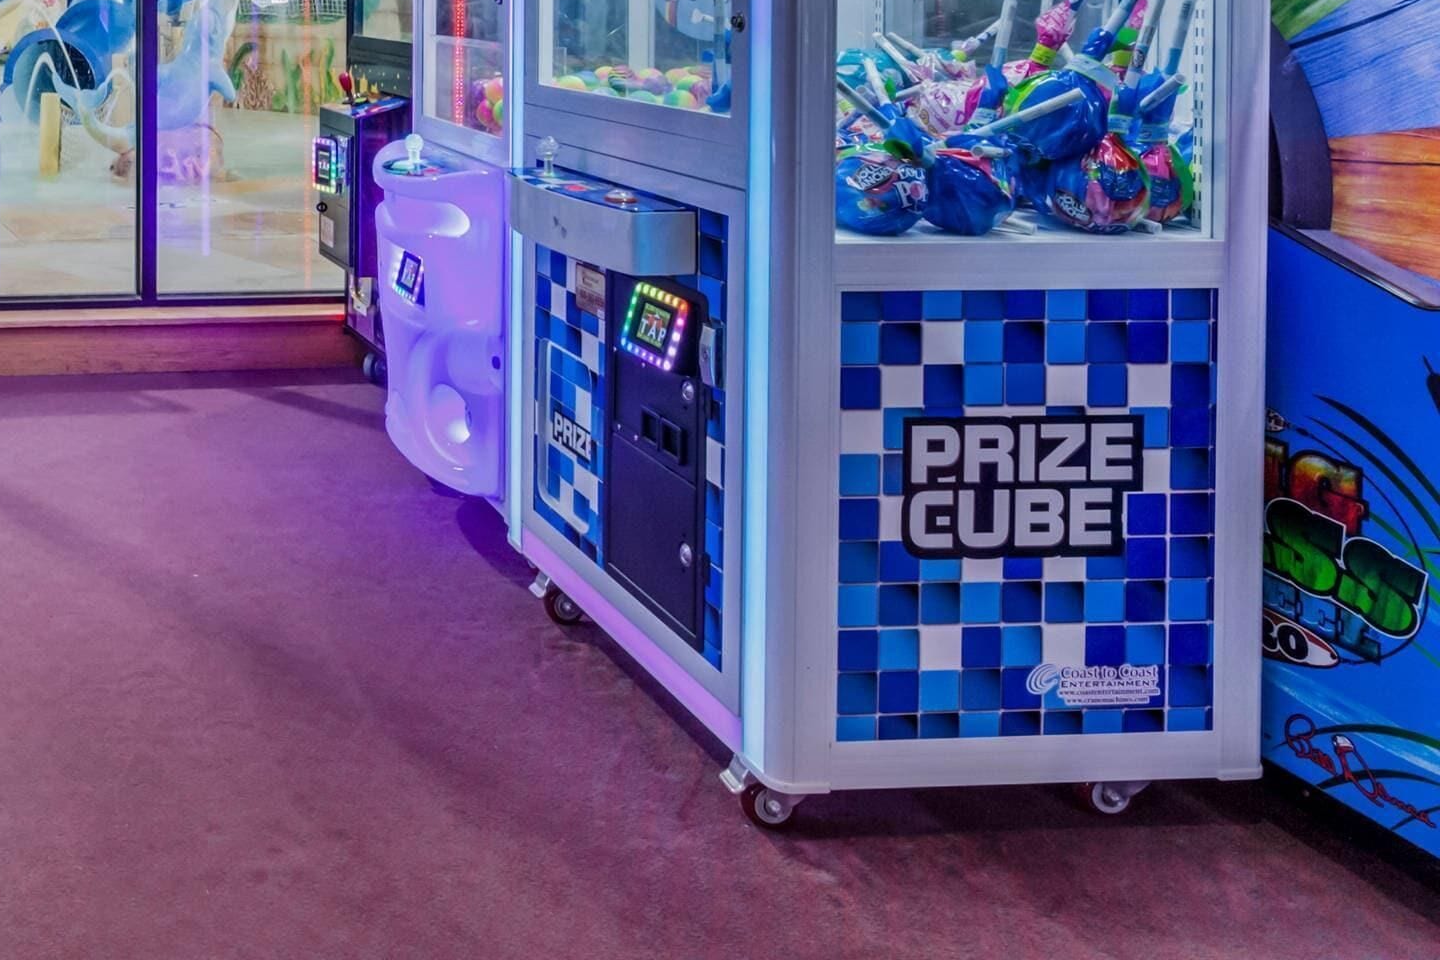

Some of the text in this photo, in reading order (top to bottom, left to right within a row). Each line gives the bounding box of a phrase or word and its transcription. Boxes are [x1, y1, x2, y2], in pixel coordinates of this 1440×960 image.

[640, 318, 667, 342] TAP
[911, 422, 1134, 483] PRIZE
[909, 487, 1113, 548] CUBE
[1264, 498, 1429, 639] SS
[1061, 664, 1157, 679] Coast to Coast
[1061, 680, 1157, 688] ENTERTAINMENT
